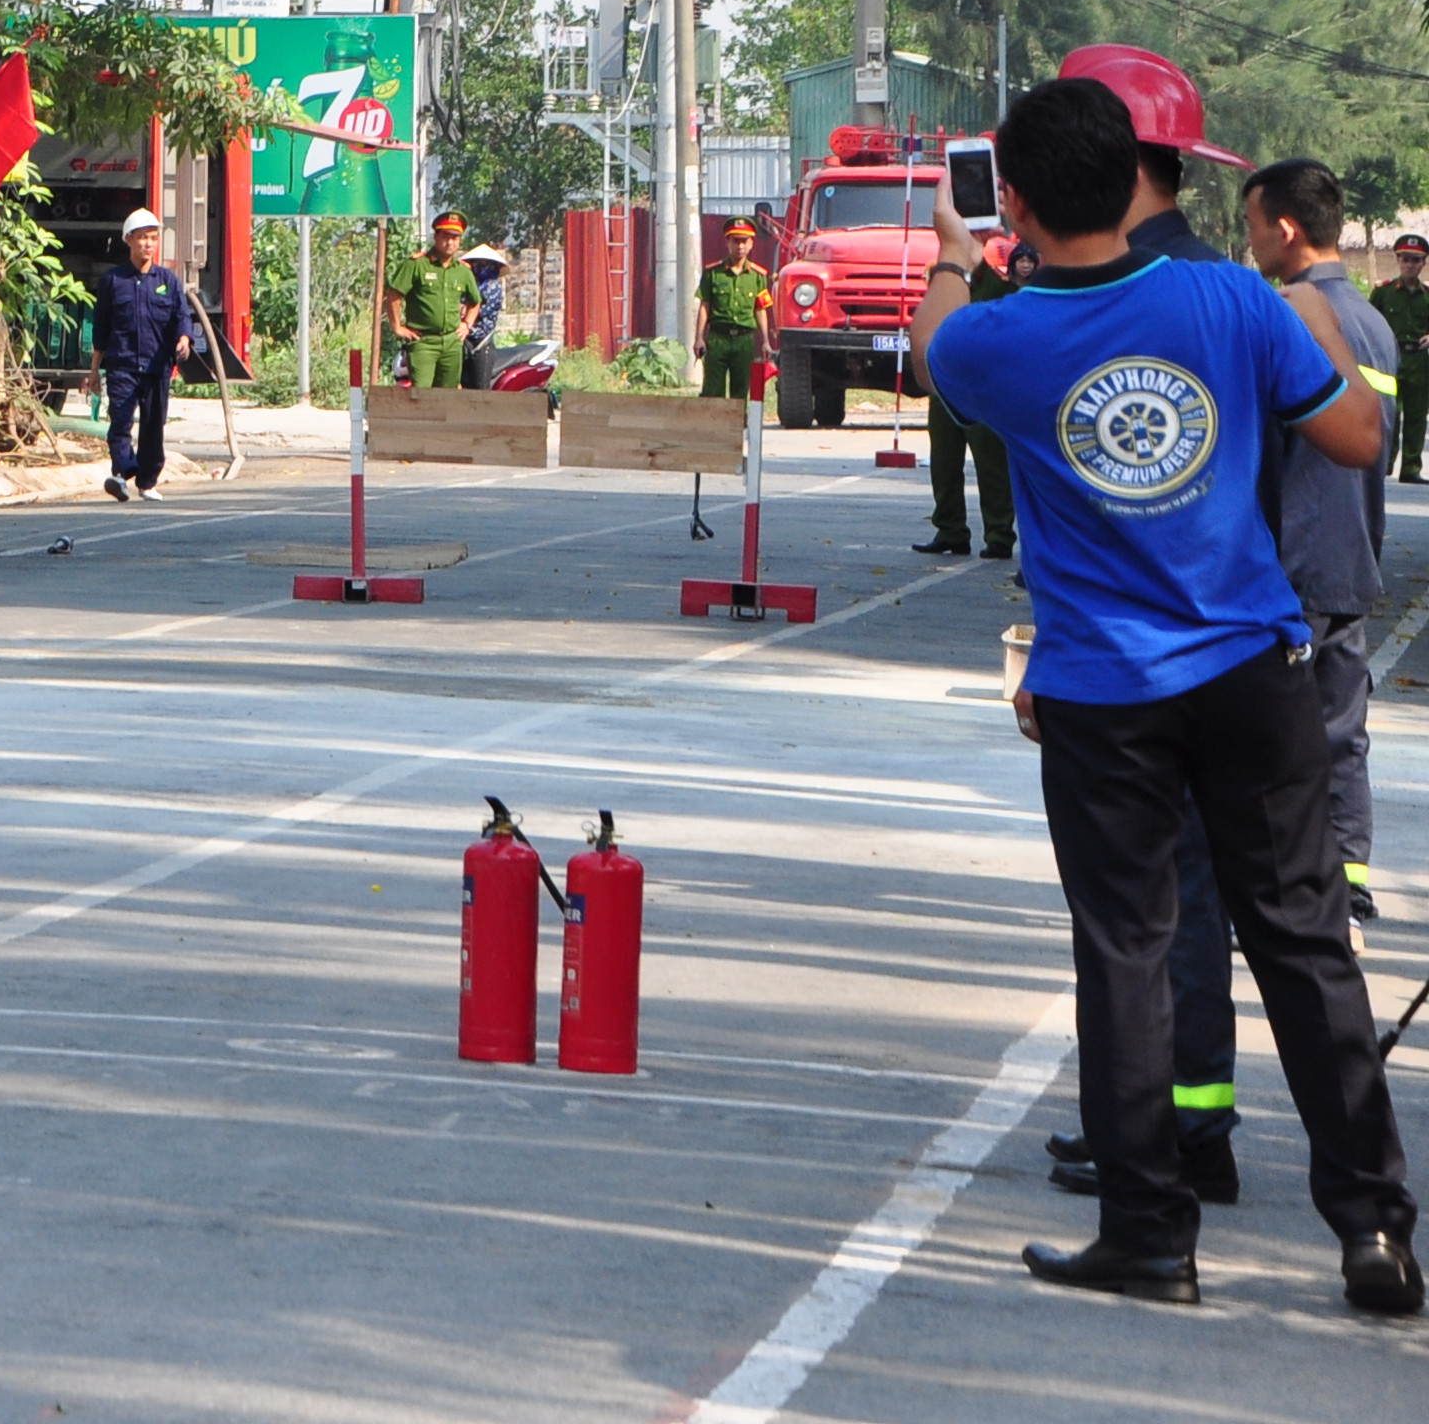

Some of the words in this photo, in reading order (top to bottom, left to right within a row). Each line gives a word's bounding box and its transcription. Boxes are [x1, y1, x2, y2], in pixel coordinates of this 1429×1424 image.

[254, 183, 285, 196] PHÒNG
[1074, 369, 1188, 418] HAIPHONG
[1092, 453, 1162, 483] PREMIUM
[1161, 439, 1197, 474] BEER
